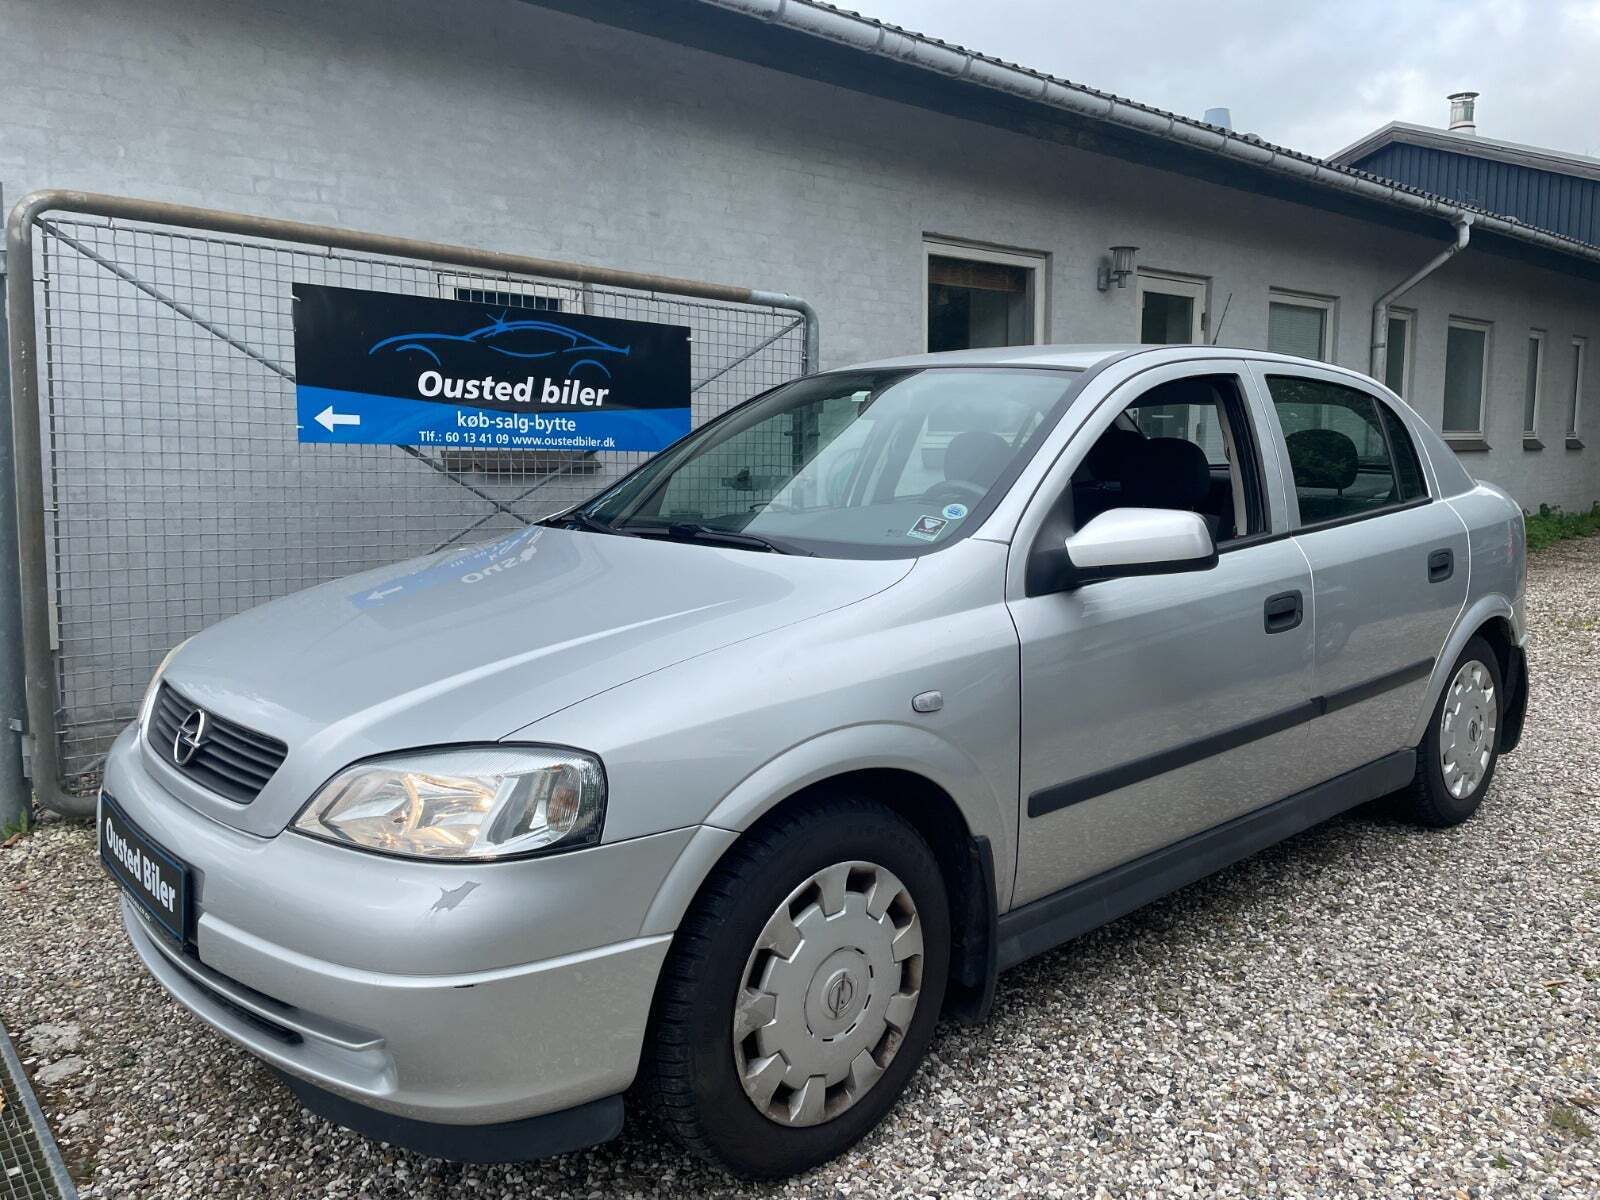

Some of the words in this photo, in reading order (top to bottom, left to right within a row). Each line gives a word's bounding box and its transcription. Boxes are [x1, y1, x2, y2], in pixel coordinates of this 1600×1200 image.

[417, 370, 534, 402] Ousted
[540, 378, 609, 407] biler
[457, 410, 576, 434] køb-salg-bytte
[418, 430, 442, 442] Tlf.:
[445, 431, 460, 443] 60
[463, 432, 477, 443] 13
[479, 433, 492, 444] 41
[495, 433, 509, 444] 09
[512, 435, 616, 448] www.oustedbiler.dk
[106, 817, 142, 882] Ousted
[143, 855, 176, 913] Biler
